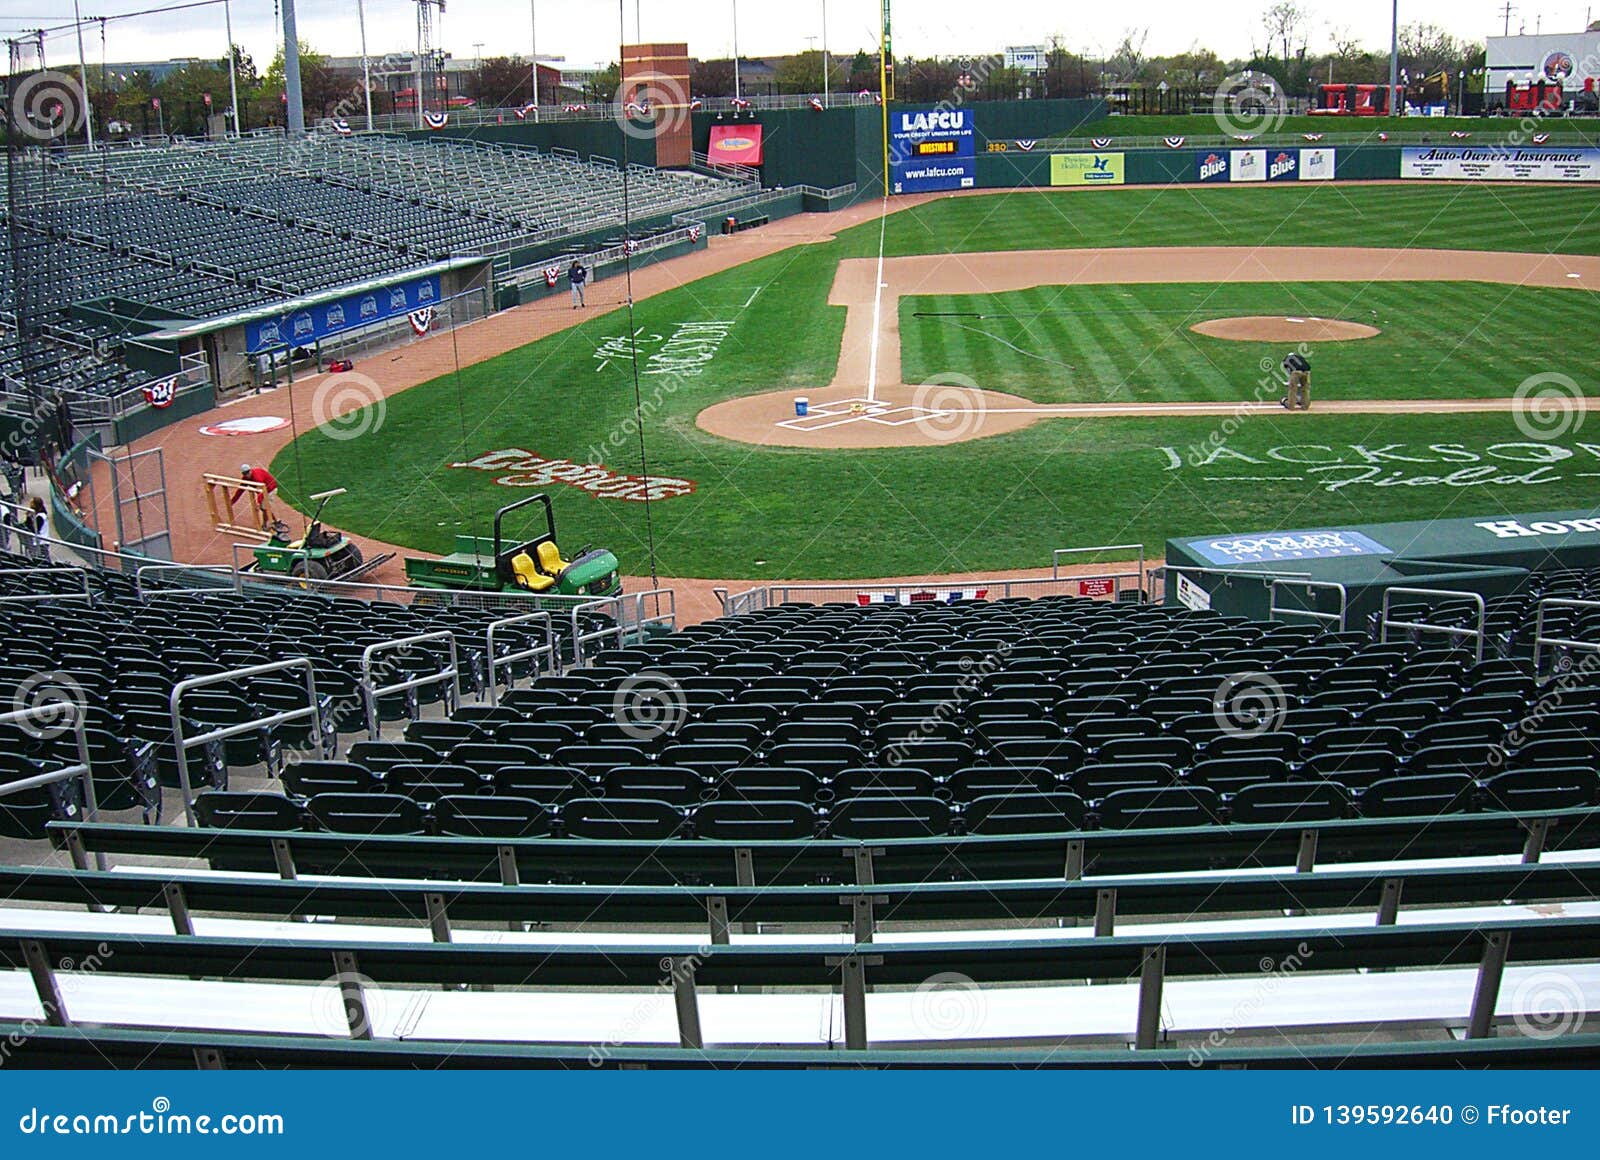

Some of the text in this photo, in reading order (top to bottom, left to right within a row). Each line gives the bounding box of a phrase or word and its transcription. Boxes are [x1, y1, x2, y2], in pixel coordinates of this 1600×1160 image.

[902, 111, 963, 131] LAFCU
[1419, 149, 1582, 162] Auto-Owners Insurance
[905, 167, 964, 179] www.lafcu.com
[1200, 160, 1226, 180] Blue
[1270, 159, 1295, 179] Blue
[447, 448, 697, 502] Lugnuts
[1307, 466, 1562, 492] Field
